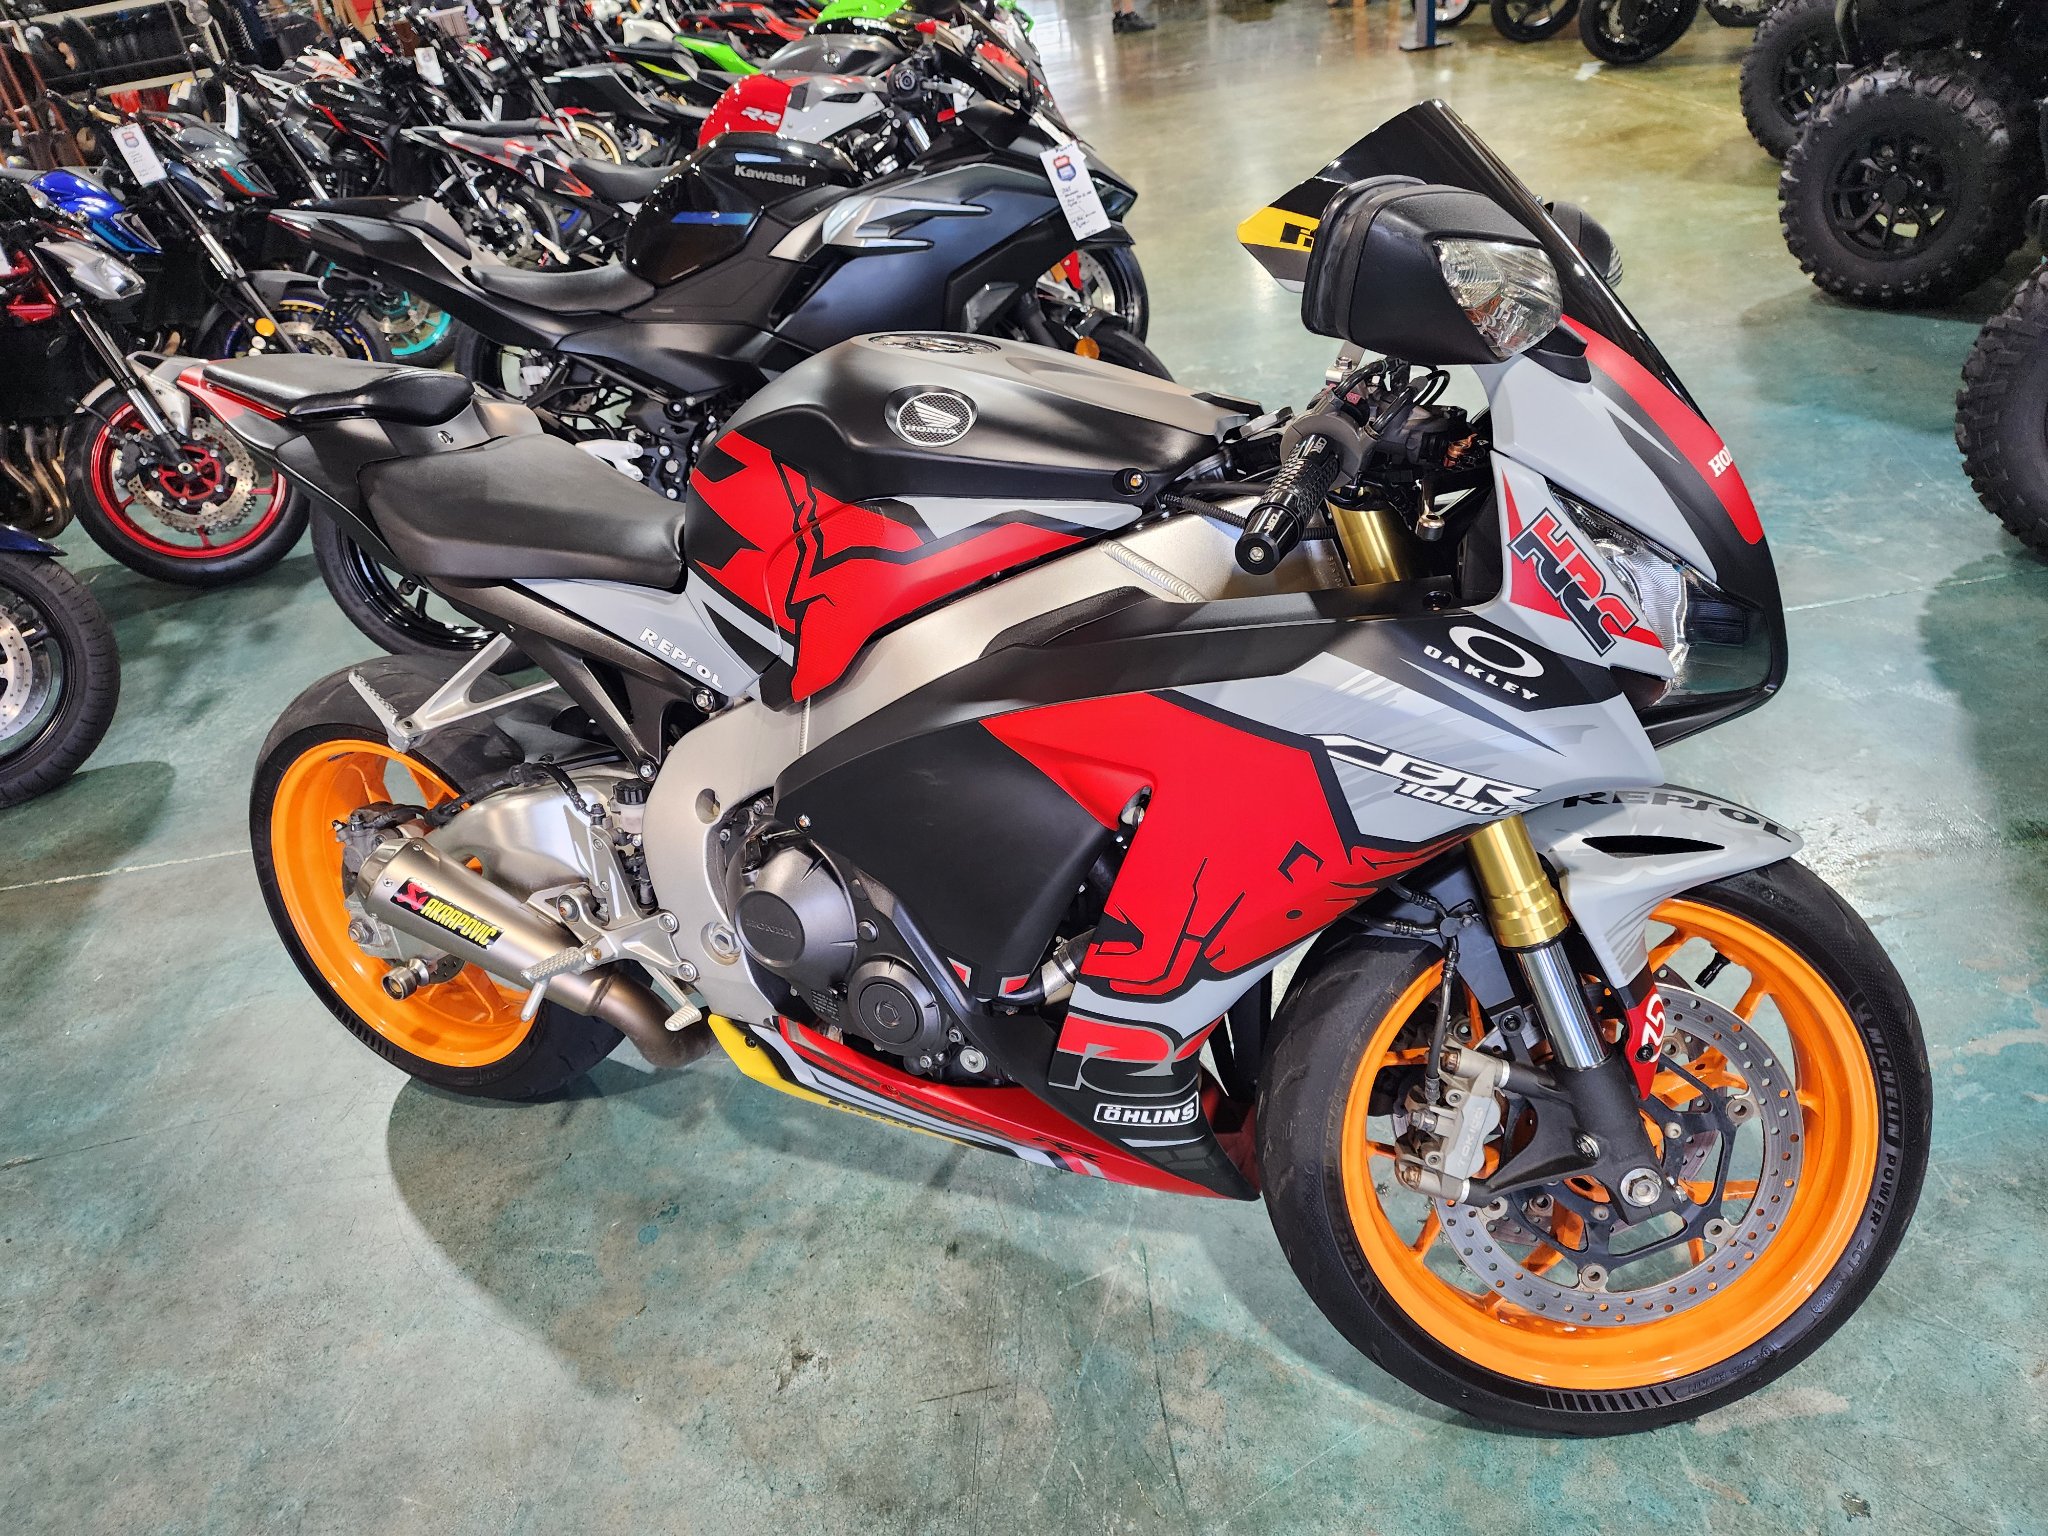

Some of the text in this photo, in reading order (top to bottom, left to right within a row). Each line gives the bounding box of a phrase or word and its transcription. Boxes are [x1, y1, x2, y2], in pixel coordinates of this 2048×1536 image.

[741, 106, 781, 126] RR
[734, 165, 806, 187] Kawasaki
[905, 424, 960, 435] HONDA
[1507, 507, 1639, 657] HRC
[639, 627, 723, 689] REPSOL
[1423, 645, 1540, 700] OAKLEY
[1307, 734, 1541, 806] CBR
[1562, 791, 1793, 843] REPSOL
[1865, 1026, 1901, 1139] MICHELIN
[1103, 1101, 1195, 1124] ÖHLINS
